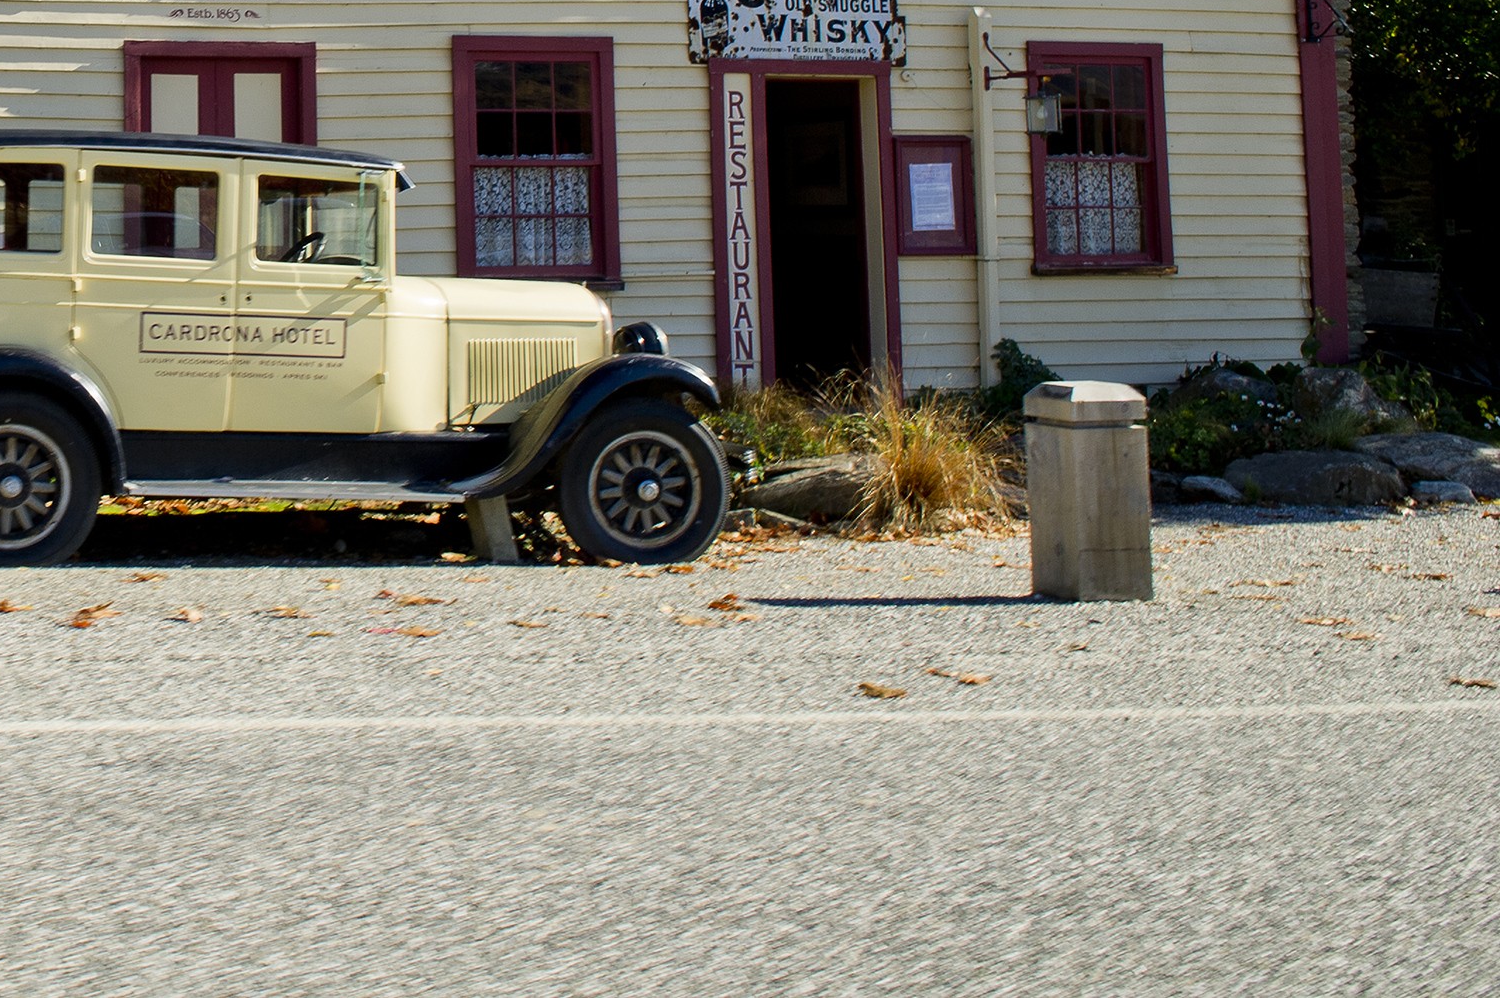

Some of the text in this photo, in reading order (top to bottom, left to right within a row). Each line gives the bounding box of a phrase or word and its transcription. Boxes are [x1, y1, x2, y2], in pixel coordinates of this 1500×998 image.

[216, 7, 241, 23] 1863
[756, 13, 893, 43] WHISKY
[803, 46, 835, 54] STIRLING
[836, 46, 866, 54] BONDING
[727, 90, 755, 388] RESTAURANT
[148, 322, 337, 346] CARDRONA HOTEL
